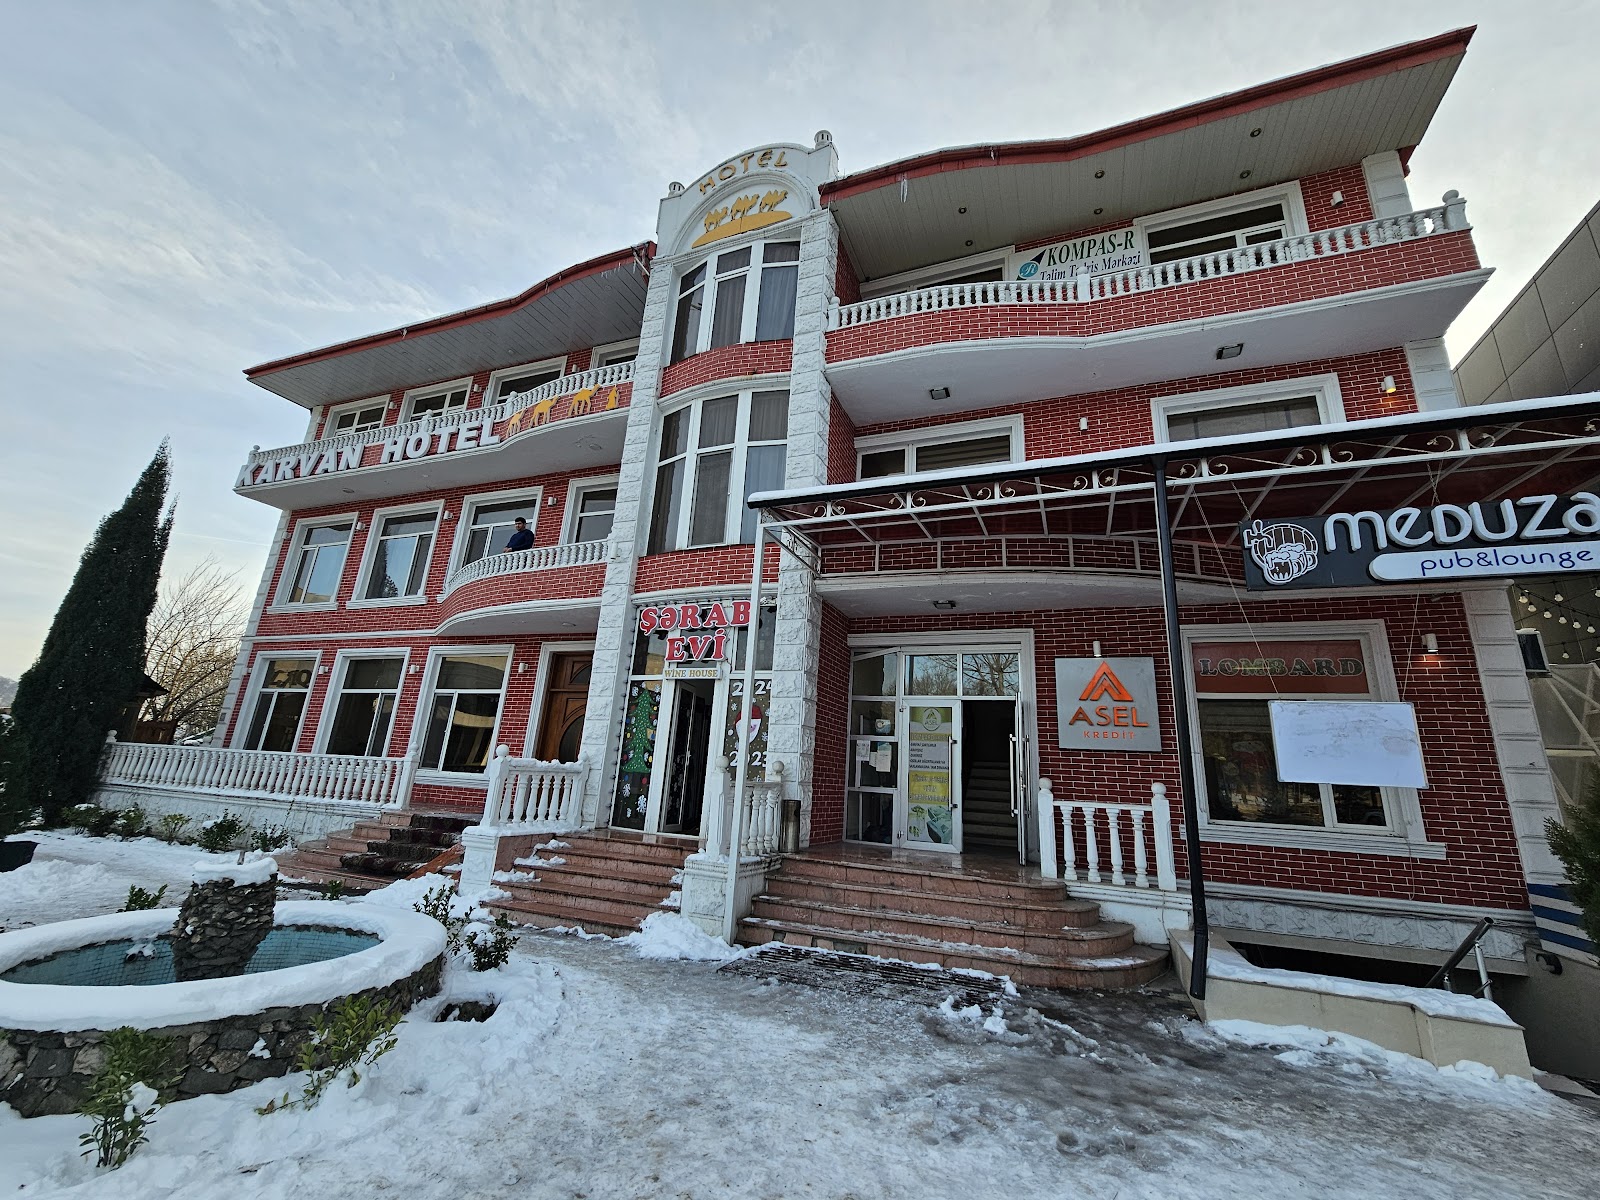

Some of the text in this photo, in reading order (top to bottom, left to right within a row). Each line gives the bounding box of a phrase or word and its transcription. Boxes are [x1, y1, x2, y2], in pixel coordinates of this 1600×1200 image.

[699, 149, 788, 195] HOTEL
[1047, 230, 1135, 267] KOMPAS-R
[234, 418, 500, 487] KARVAN HOTEL
[1420, 549, 1594, 577] pub&lounge
[640, 600, 751, 636] ŞƏRAB
[665, 628, 727, 662] EVİ
[688, 668, 719, 678] HOUSE
[1199, 658, 1364, 676] LOMBARD
[731, 680, 772, 697] 224
[1068, 705, 1150, 728] ASEL
[729, 750, 768, 768] 223
